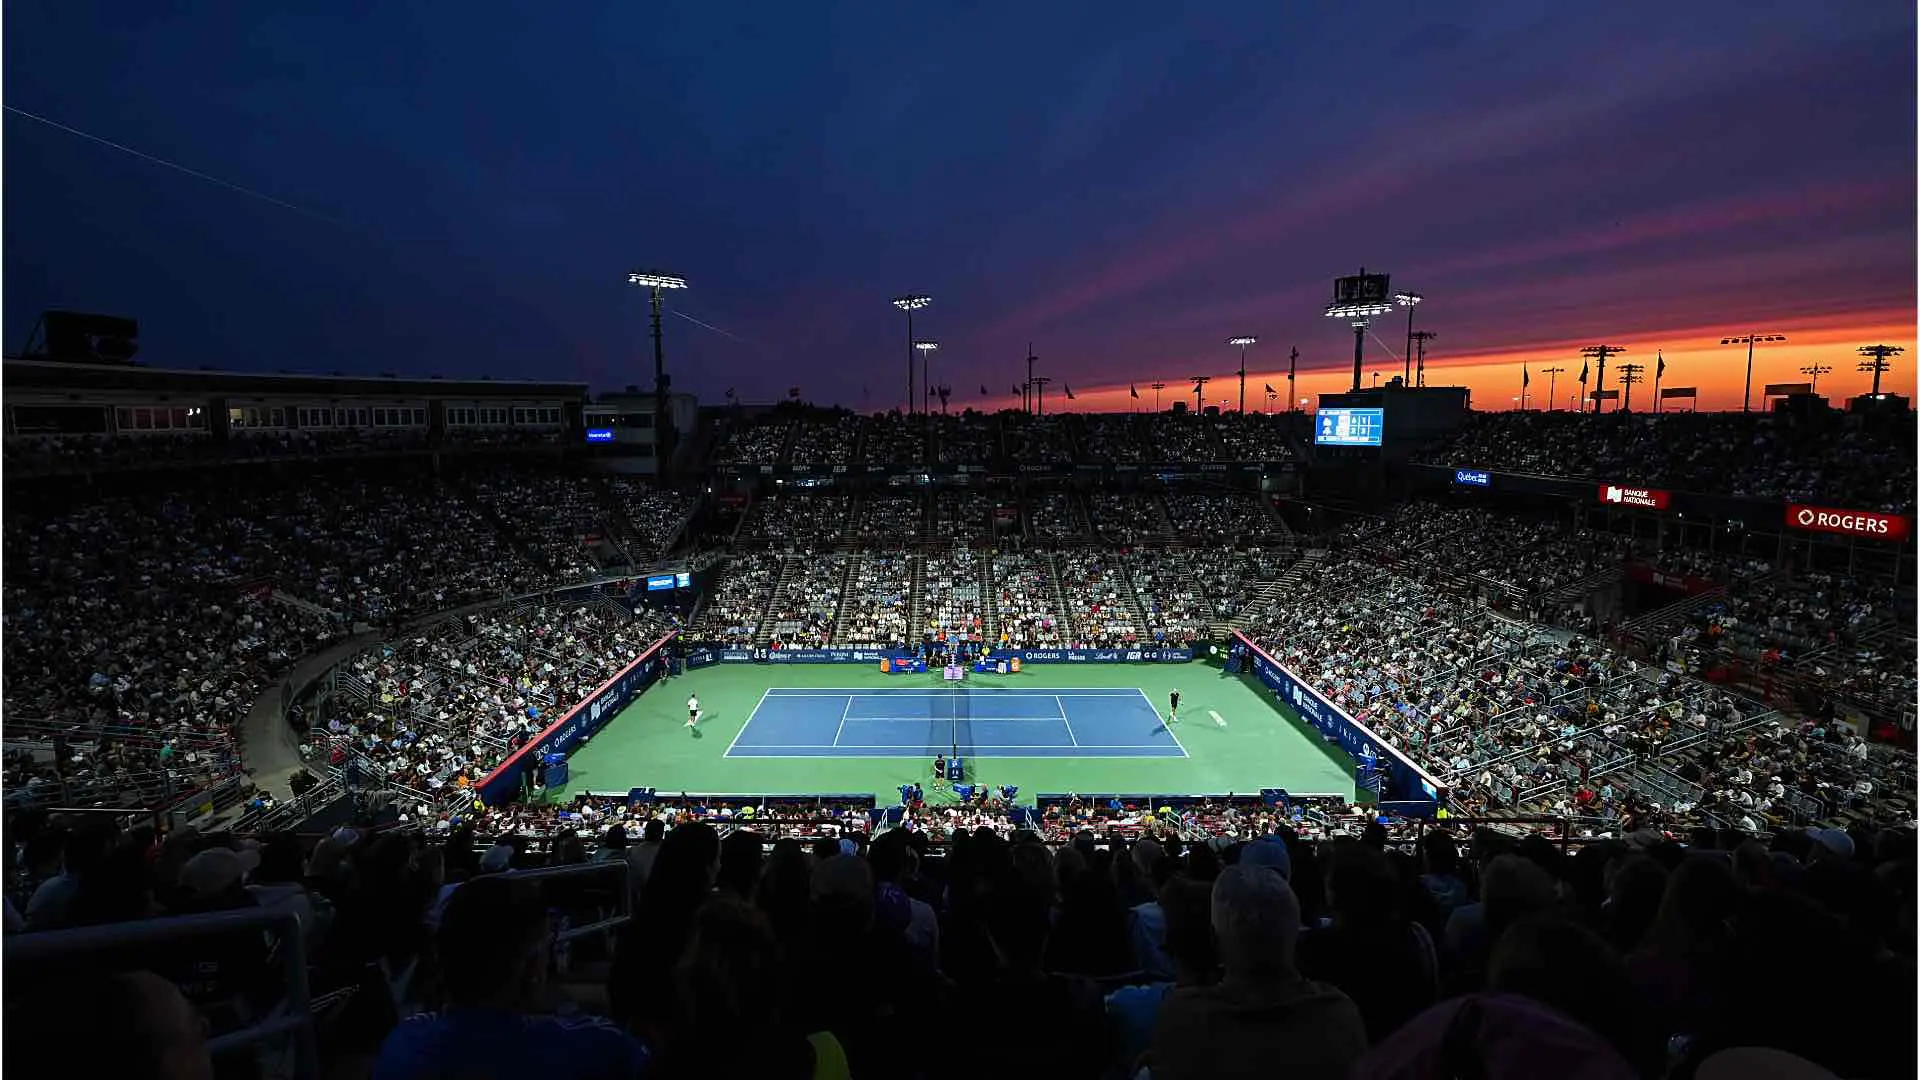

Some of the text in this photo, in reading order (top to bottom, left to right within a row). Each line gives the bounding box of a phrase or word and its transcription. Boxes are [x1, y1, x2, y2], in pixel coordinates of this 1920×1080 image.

[1624, 489, 1649, 498] BANQUE
[1623, 496, 1656, 506] NATIONALE
[1817, 512, 1889, 534] ROGERS
[1033, 651, 1060, 659] ROGERS
